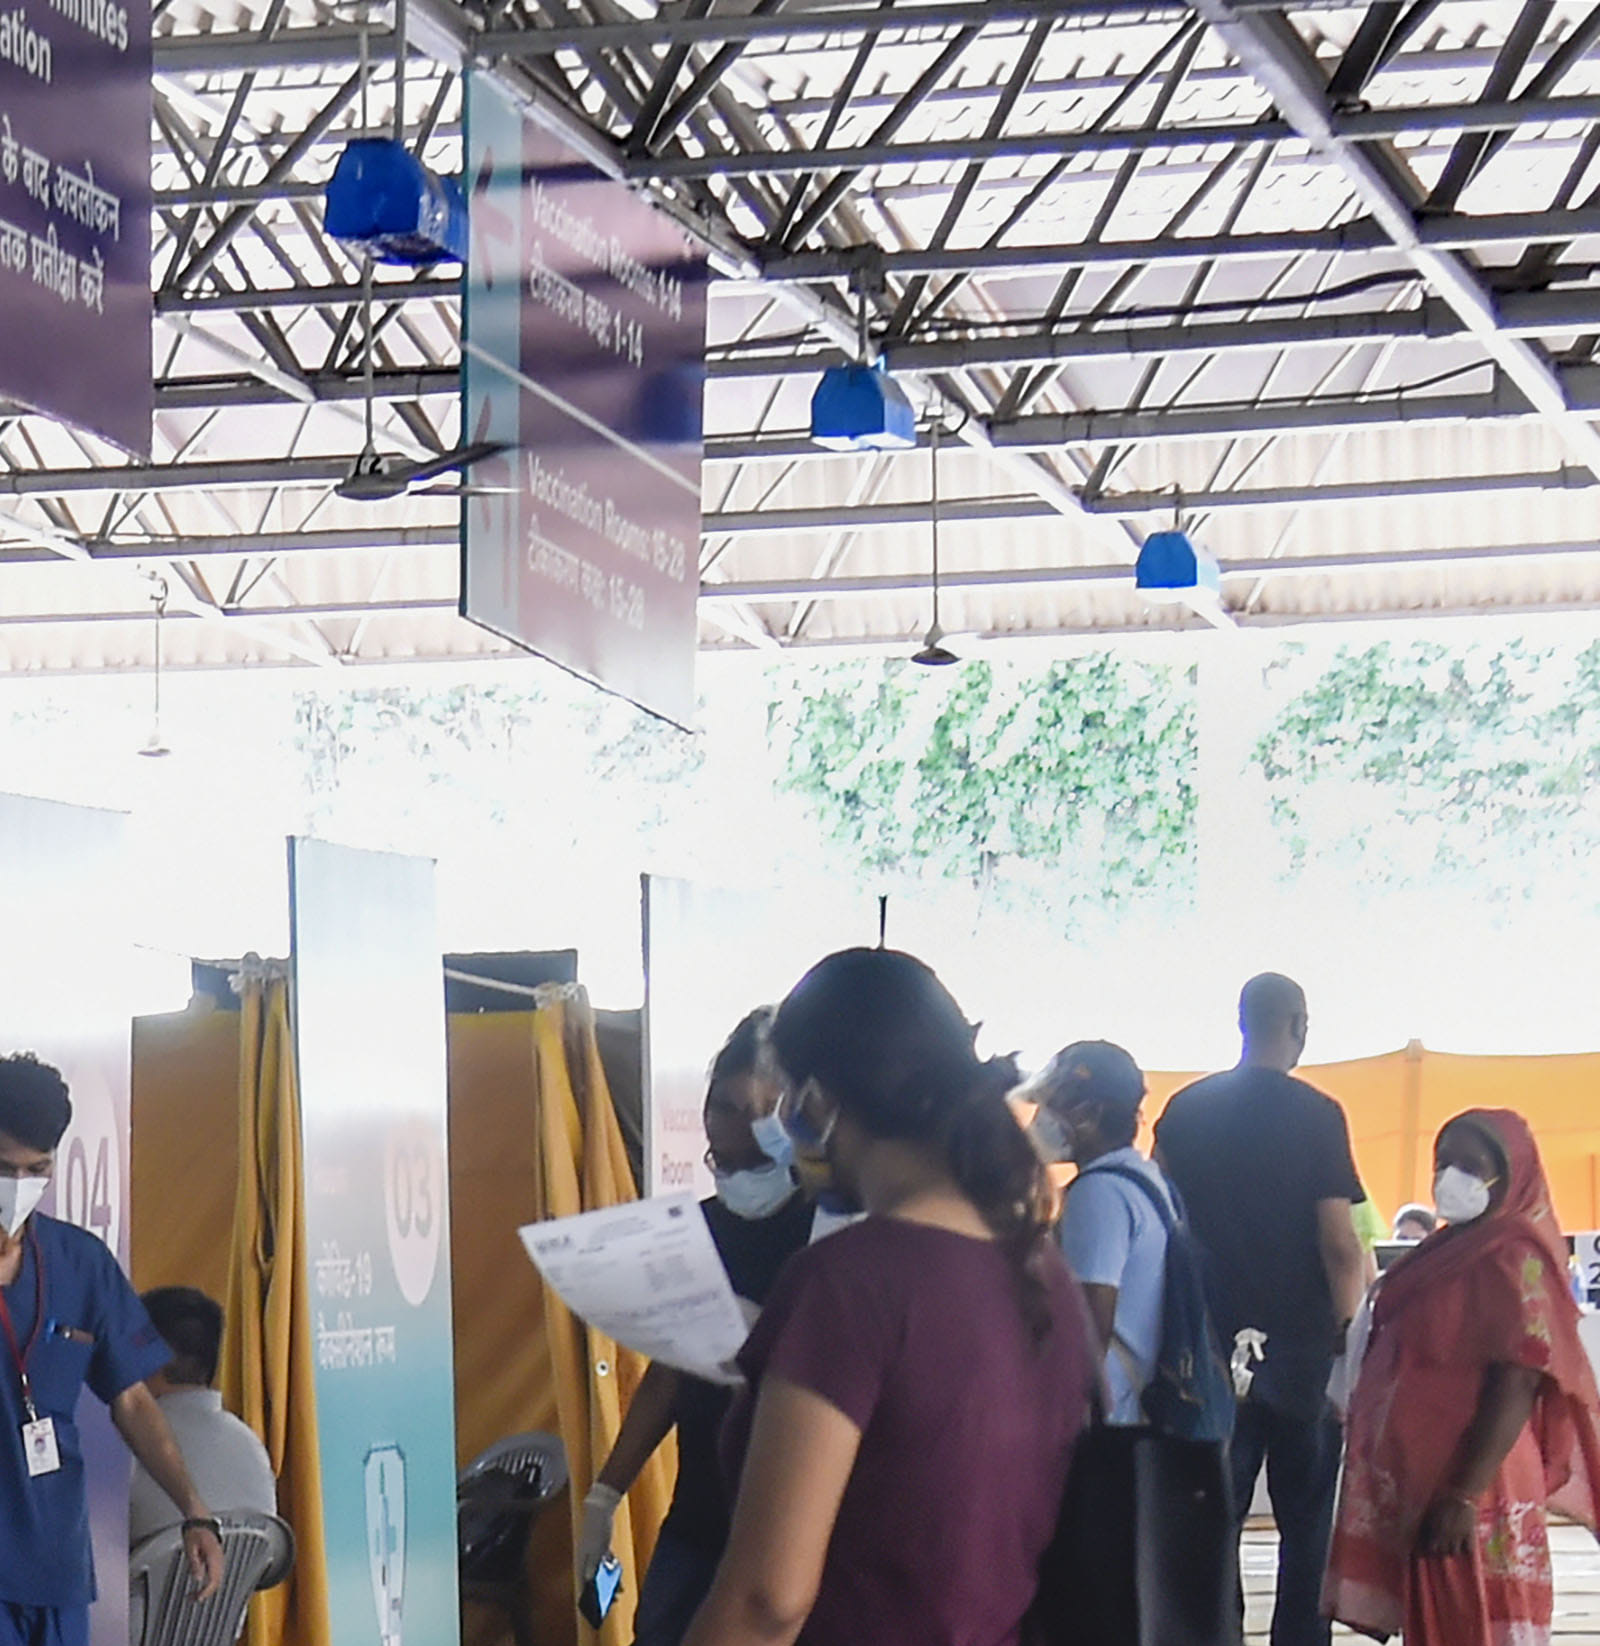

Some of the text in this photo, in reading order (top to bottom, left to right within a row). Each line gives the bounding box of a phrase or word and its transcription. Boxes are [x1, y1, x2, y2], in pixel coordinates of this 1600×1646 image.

[49, 0, 129, 51] nutes
[2, 114, 18, 184] के
[22, 147, 50, 209] बाद
[54, 160, 120, 242] अवलोकन
[530, 175, 608, 271] Vaccination
[0, 218, 28, 273] तक
[31, 222, 77, 303] प्रतीक्षा
[614, 309, 644, 368] 1-14
[528, 451, 602, 534] Vaccination
[66, 1137, 111, 1246] 04
[394, 1140, 433, 1239] 03
